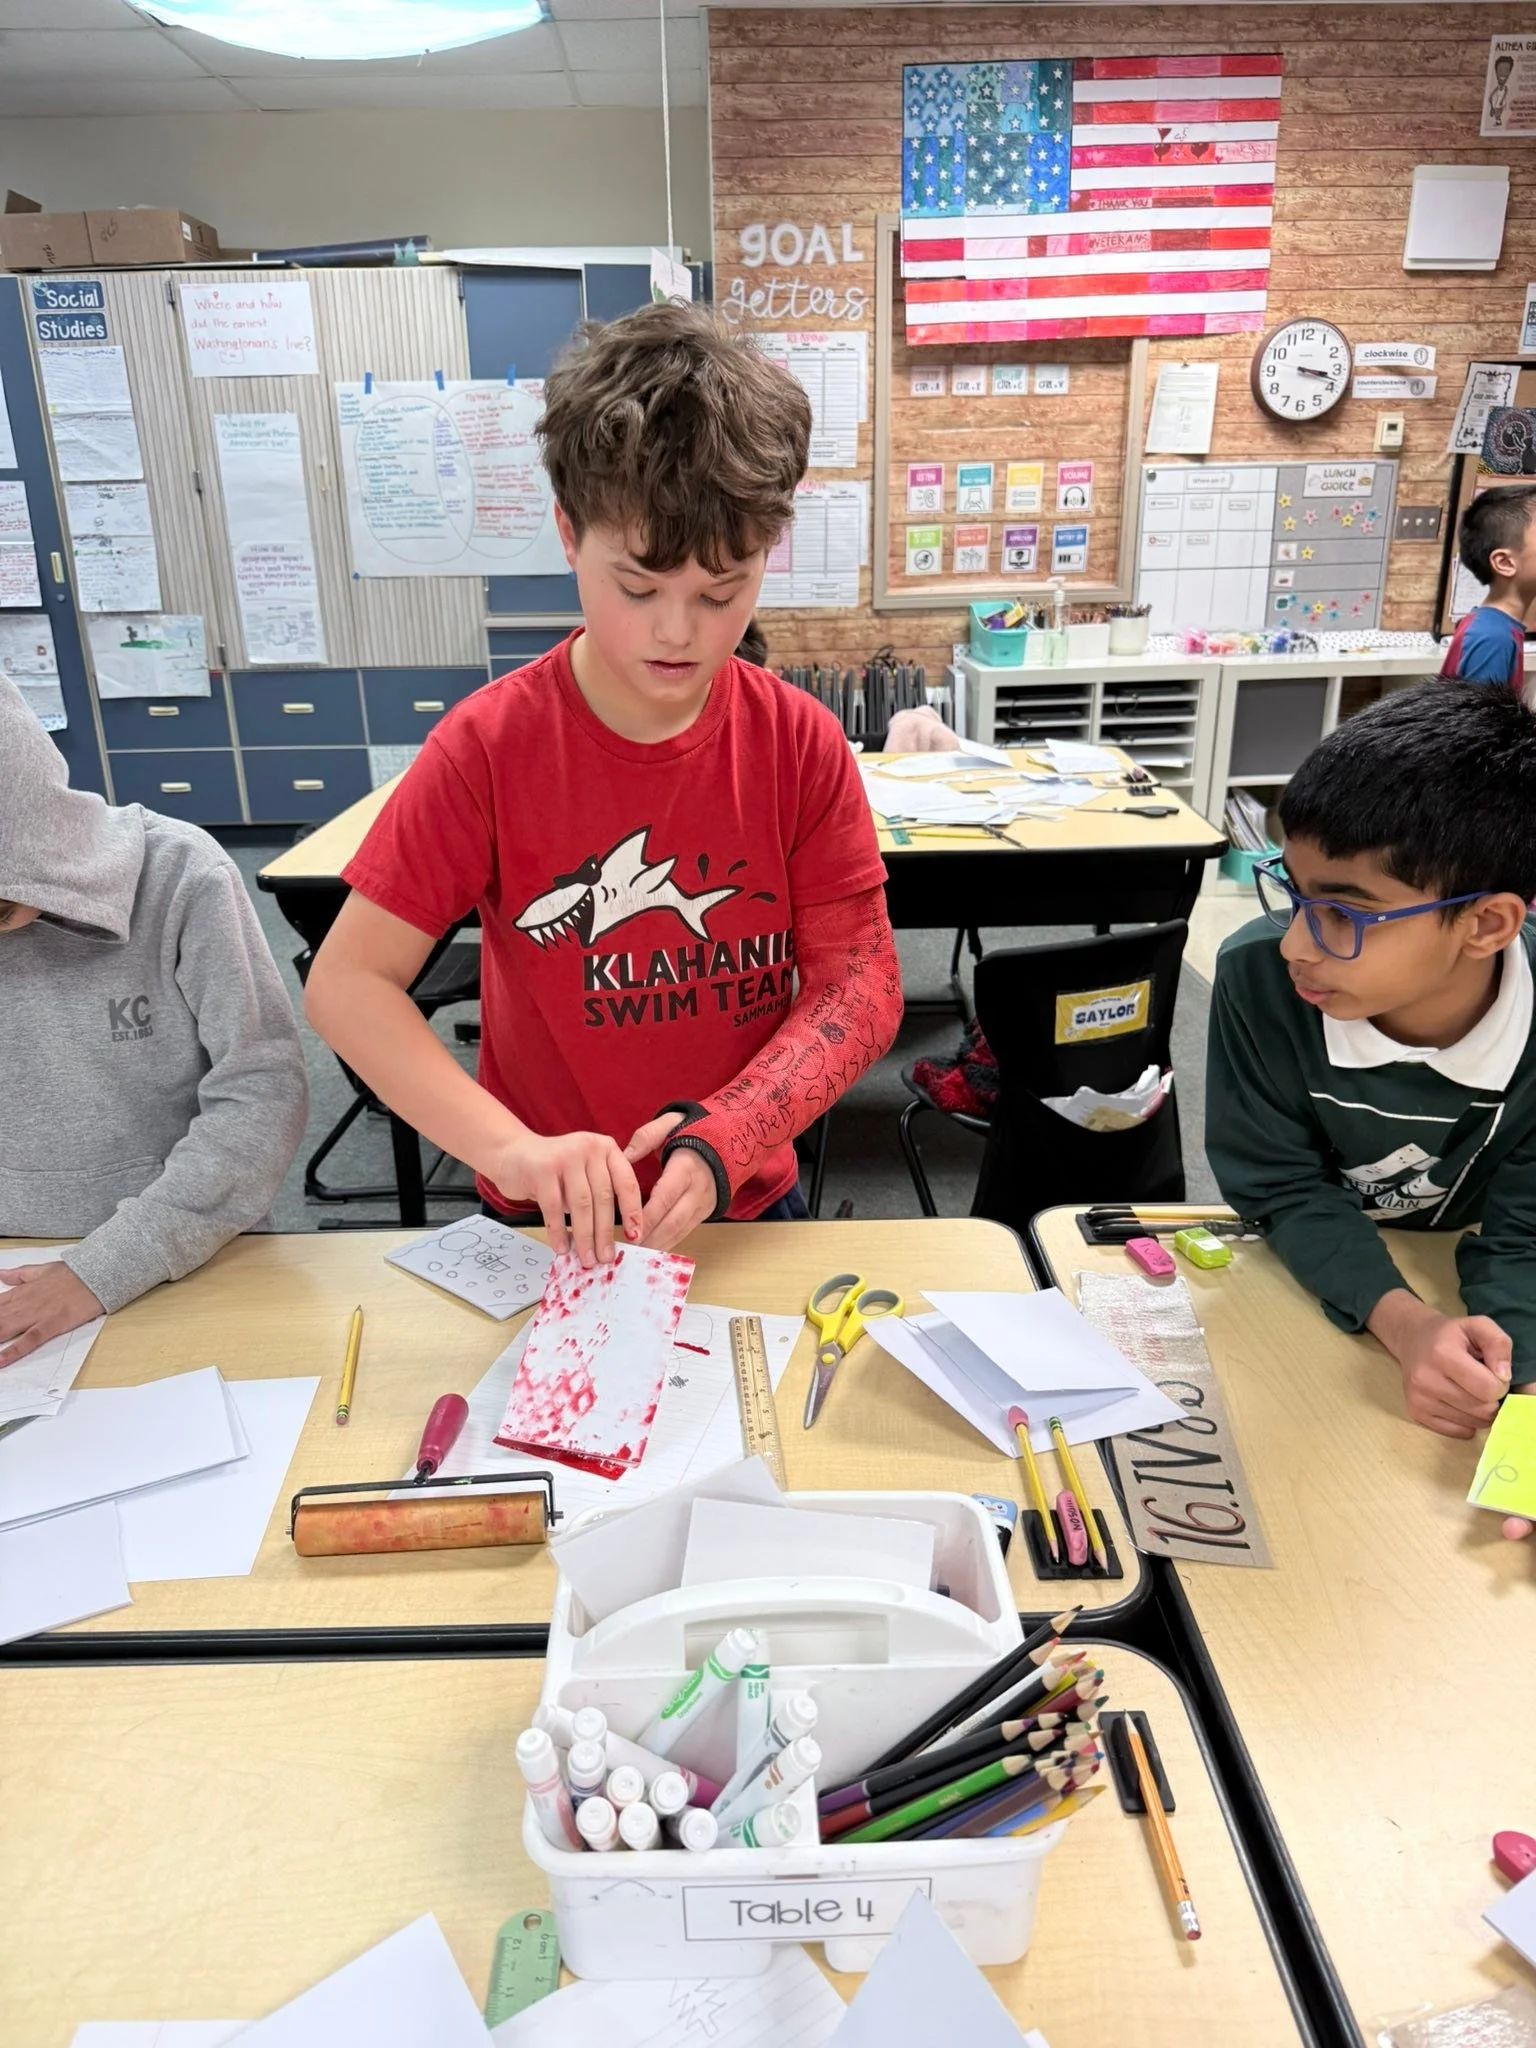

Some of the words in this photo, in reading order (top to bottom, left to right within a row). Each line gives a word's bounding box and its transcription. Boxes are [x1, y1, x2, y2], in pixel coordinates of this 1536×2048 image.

[1496, 42, 1523, 51] ALTHEA
[1093, 234, 1149, 248] VETERANS
[46, 287, 100, 308] Social
[235, 299, 256, 309] and
[260, 299, 282, 309] how
[722, 277, 869, 325] getters
[39, 319, 106, 339] Studies
[1302, 328, 1315, 341] 12
[1287, 333, 1298, 346] 11
[1322, 333, 1327, 346] 1
[1273, 347, 1287, 361] 10
[1329, 346, 1339, 359] 2
[1364, 349, 1408, 358] clockwise
[1266, 364, 1276, 378] 9
[1332, 363, 1342, 376] 3
[1269, 382, 1280, 395] 8
[1325, 381, 1335, 393] 4
[1281, 395, 1291, 407] 7
[1295, 399, 1306, 412] 6
[1312, 394, 1323, 406] 5
[1323, 469, 1356, 478] LUNCH
[1321, 482, 1355, 491] CHOICE
[108, 995, 151, 1030] KC
[584, 987, 698, 1028] SWIM
[730, 1899, 843, 1927] Table
[856, 1897, 874, 1922] 4
[512, 1938, 522, 1951] 12
[505, 1986, 515, 1998] 11
